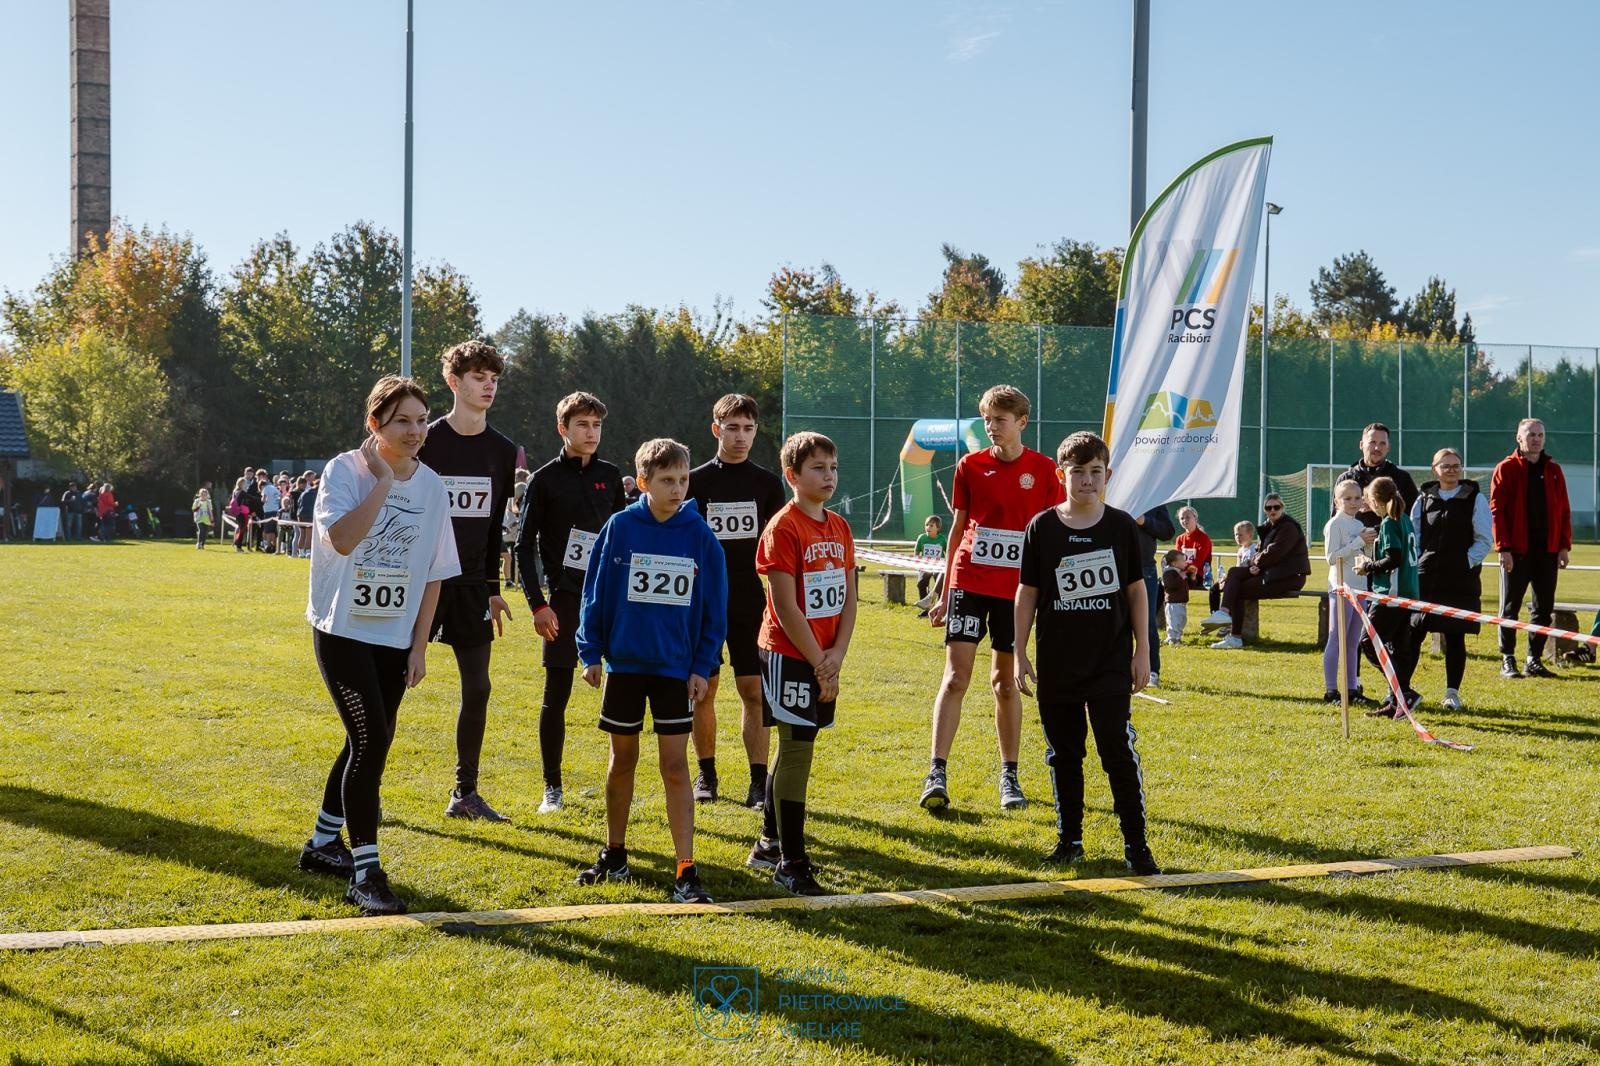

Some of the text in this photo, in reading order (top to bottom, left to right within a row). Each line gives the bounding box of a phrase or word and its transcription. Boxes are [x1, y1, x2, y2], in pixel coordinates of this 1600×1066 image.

[1170, 308, 1216, 330] PCS
[1167, 333, 1211, 343] Racibórz
[1135, 435, 1170, 447] powiat
[710, 515, 755, 533] 309
[568, 543, 592, 561] 3
[924, 548, 941, 556] 237
[974, 540, 1020, 560] 308
[632, 571, 690, 596] 320
[1061, 566, 1114, 592] 300
[353, 584, 406, 608] 303
[809, 585, 846, 609] 305
[1053, 598, 1112, 611] INSTALKOL
[783, 681, 811, 709] 55
